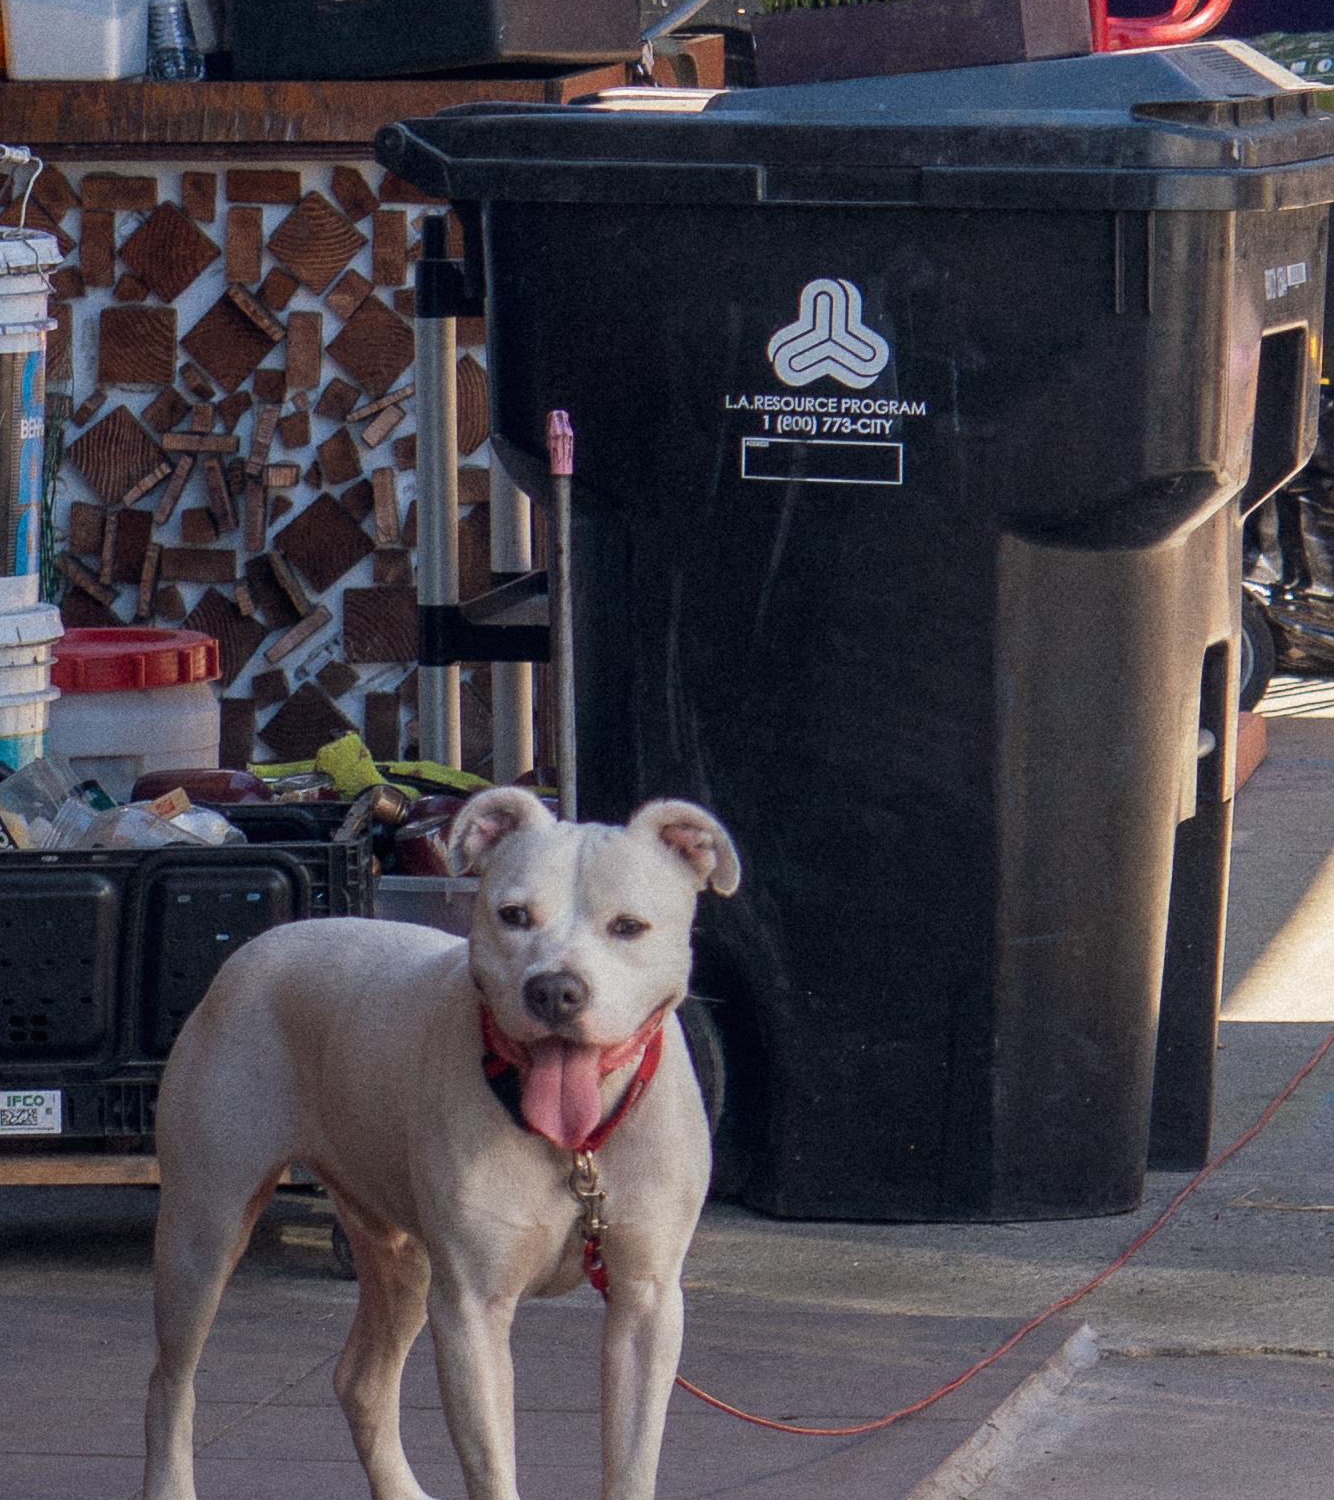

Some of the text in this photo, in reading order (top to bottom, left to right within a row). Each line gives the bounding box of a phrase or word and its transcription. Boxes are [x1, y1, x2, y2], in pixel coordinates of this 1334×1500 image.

[841, 399, 927, 416] PROGRAM
[763, 414, 894, 435] 1 (800) 773-CITY
[7, 1094, 45, 1107] IFCO
